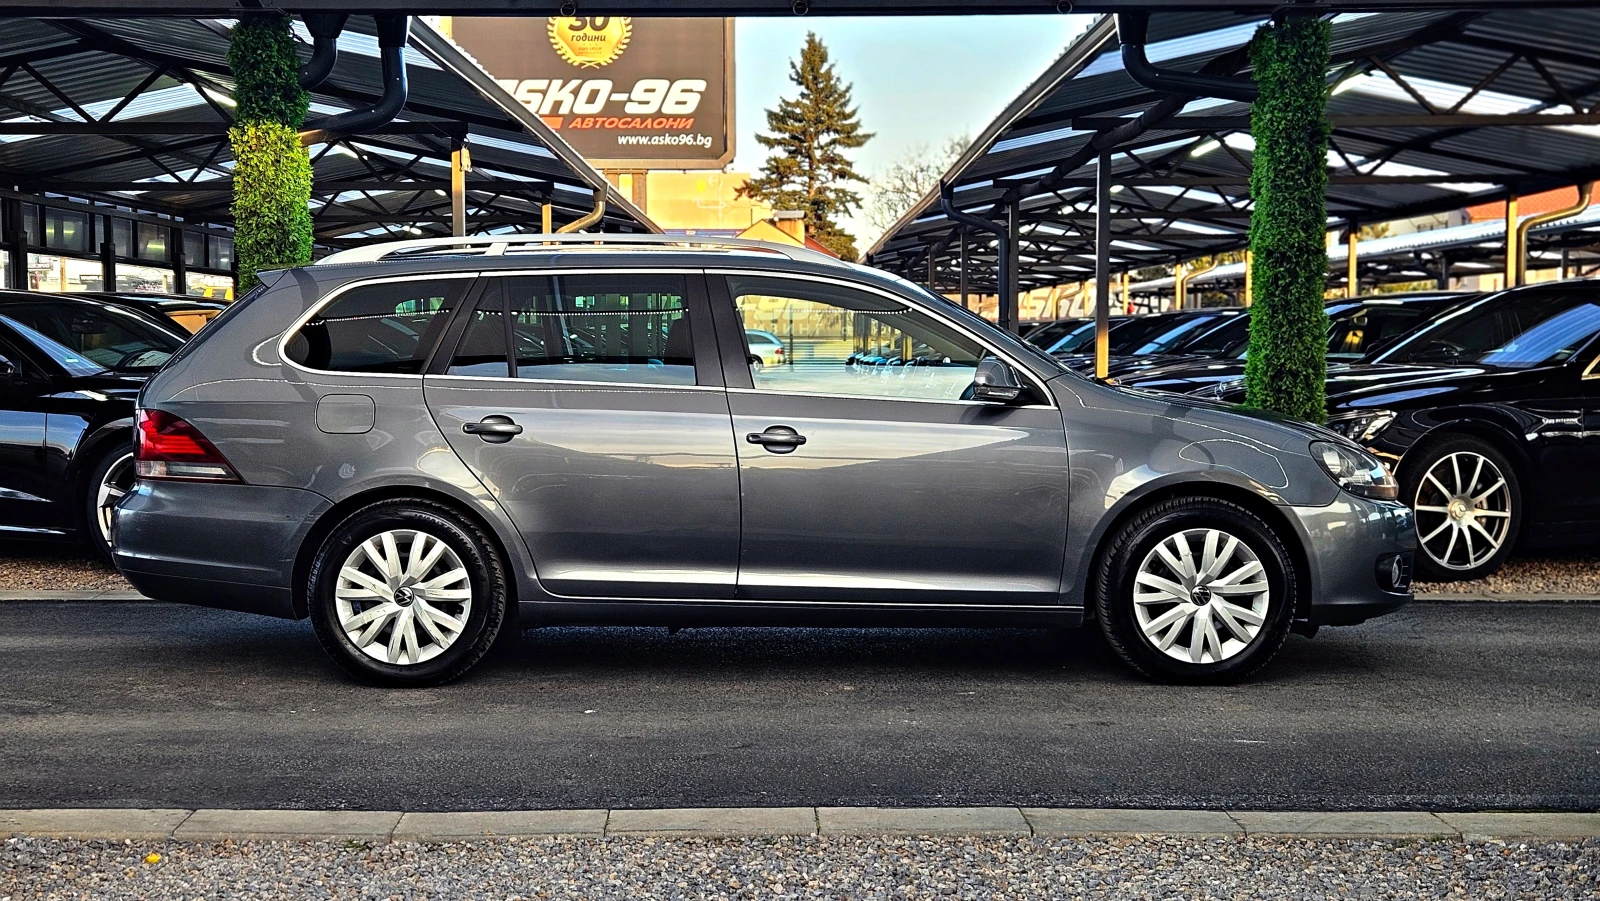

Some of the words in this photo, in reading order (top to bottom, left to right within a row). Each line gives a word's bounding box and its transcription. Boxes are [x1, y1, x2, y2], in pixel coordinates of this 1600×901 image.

[571, 33, 606, 42] години
[568, 117, 695, 129] АВТОСАЛОНИ
[617, 133, 712, 148] www.asko96.bg
